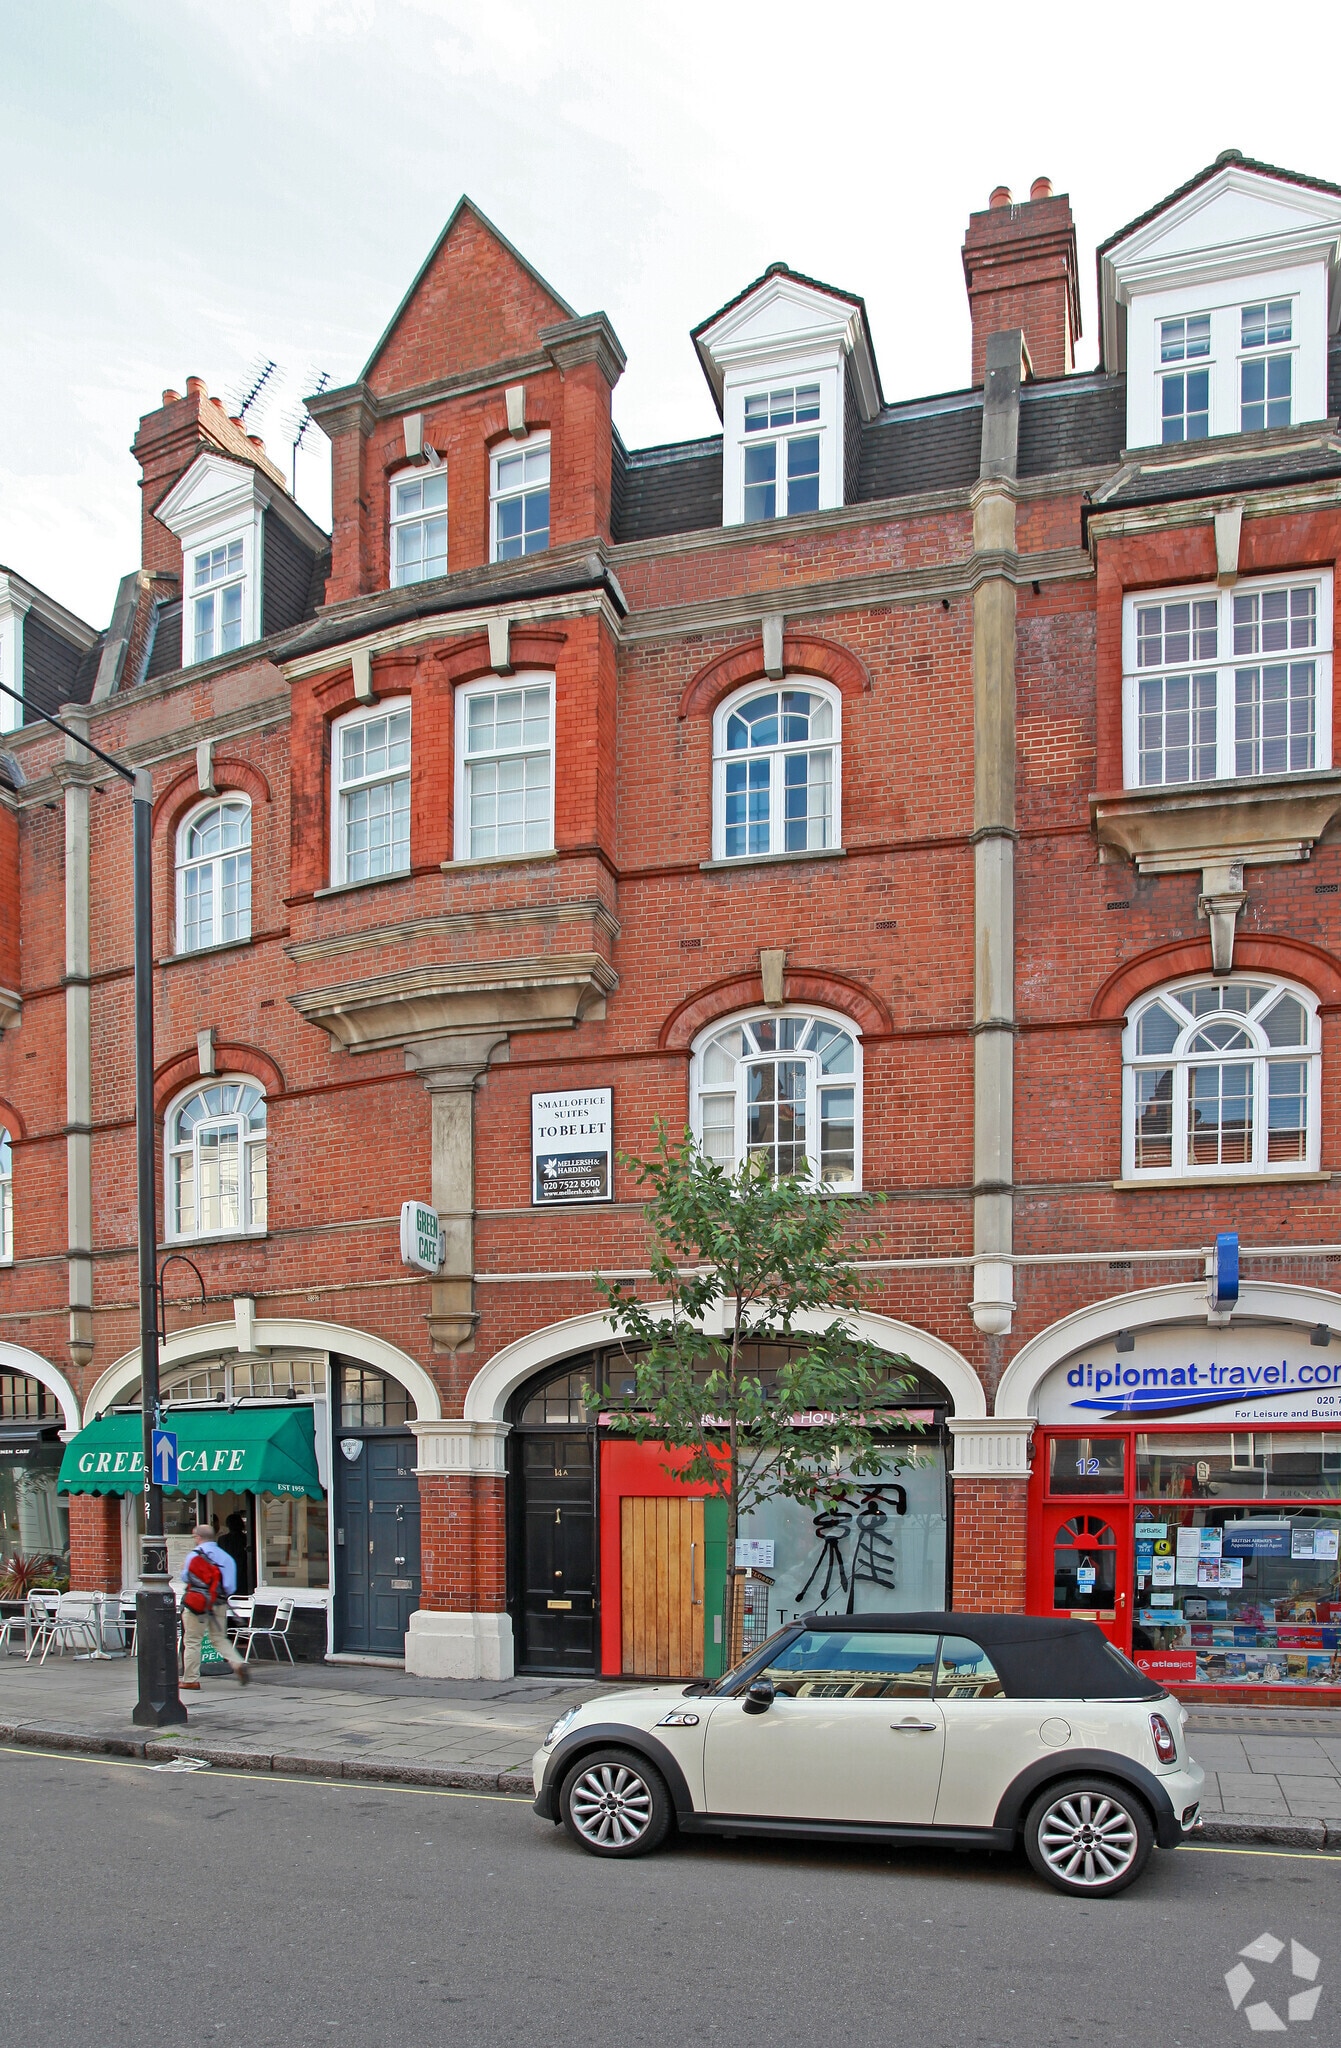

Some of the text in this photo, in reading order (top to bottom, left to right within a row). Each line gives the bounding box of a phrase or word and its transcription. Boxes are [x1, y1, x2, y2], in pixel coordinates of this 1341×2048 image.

[538, 1097, 606, 1109] SMALL OFFICE
[554, 1109, 589, 1119] SUITES
[538, 1122, 606, 1137] TO BE LET
[558, 1166, 592, 1174] HARDING
[543, 1179, 601, 1190] 020 7522 8500
[544, 1188, 601, 1197] www.mellersh.co.uk
[416, 1208, 438, 1239] GREEN
[418, 1236, 437, 1265] CAFE
[1317, 1396, 1335, 1405] 020
[1235, 1410, 1251, 1418] For
[1253, 1410, 1288, 1418] Leisure
[1291, 1409, 1309, 1417] and
[78, 1449, 246, 1473] GREE CAFE
[1075, 1458, 1100, 1475] 12
[201, 1652, 224, 1661] PEN
[1151, 1660, 1194, 1669] atlasjet
